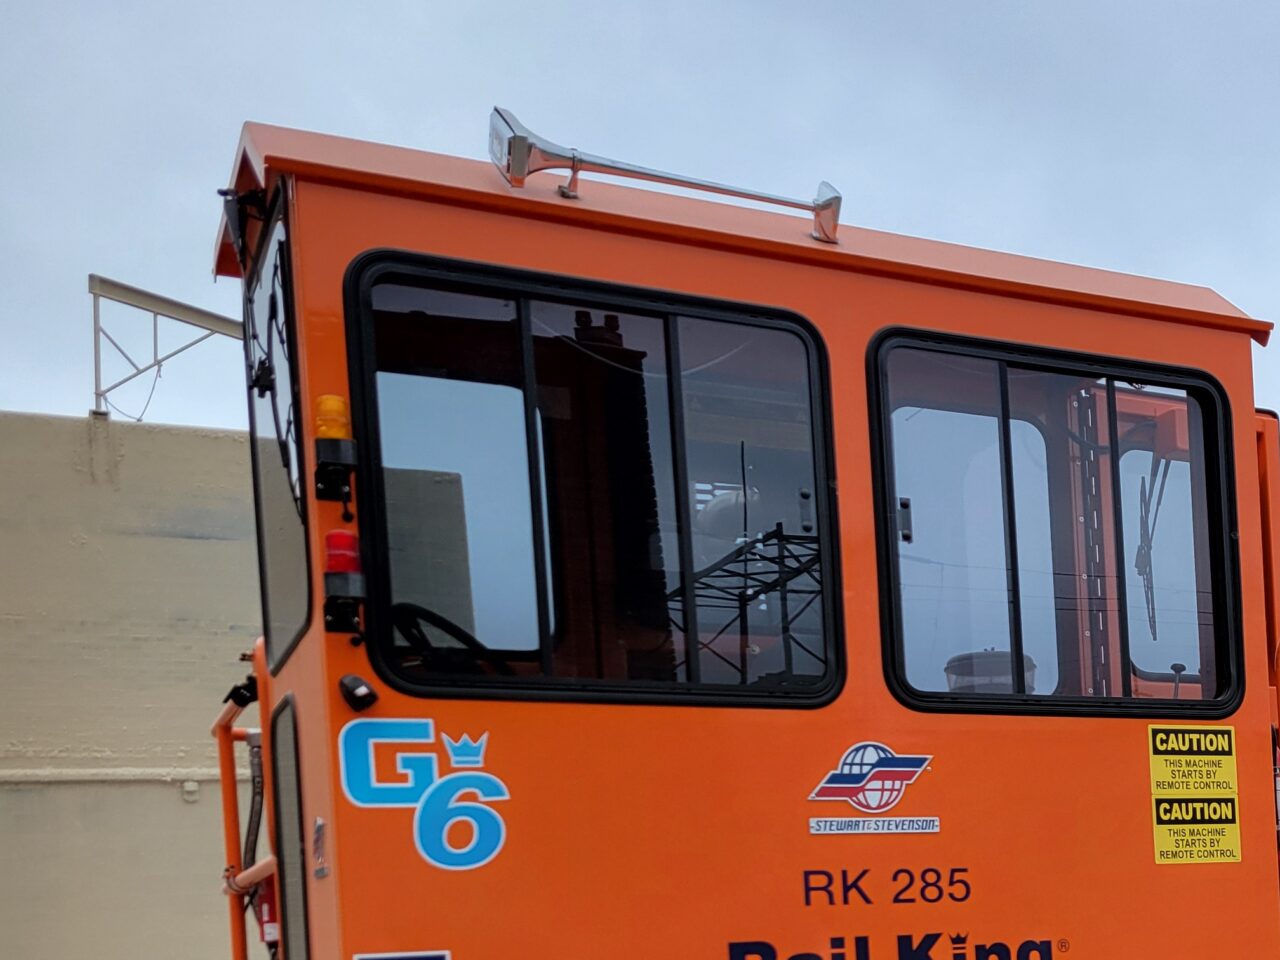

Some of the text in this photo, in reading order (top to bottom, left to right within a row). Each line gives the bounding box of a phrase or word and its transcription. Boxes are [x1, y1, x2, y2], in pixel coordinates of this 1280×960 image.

[1155, 733, 1229, 751] CAUTION
[1164, 759, 1223, 768] THIS MACHINE
[1171, 769, 1217, 779] STARTS BY
[1156, 781, 1233, 790] REMOTE CONTROL
[1160, 802, 1232, 820] CAUTION
[816, 820, 867, 831] STEWART
[873, 819, 936, 831] STEVENSON
[1168, 828, 1226, 837] THIS MACHINE
[1174, 838, 1221, 848] STARTS BY
[1159, 849, 1237, 859] REMOTE CONTROL
[803, 868, 971, 906] RK 285
